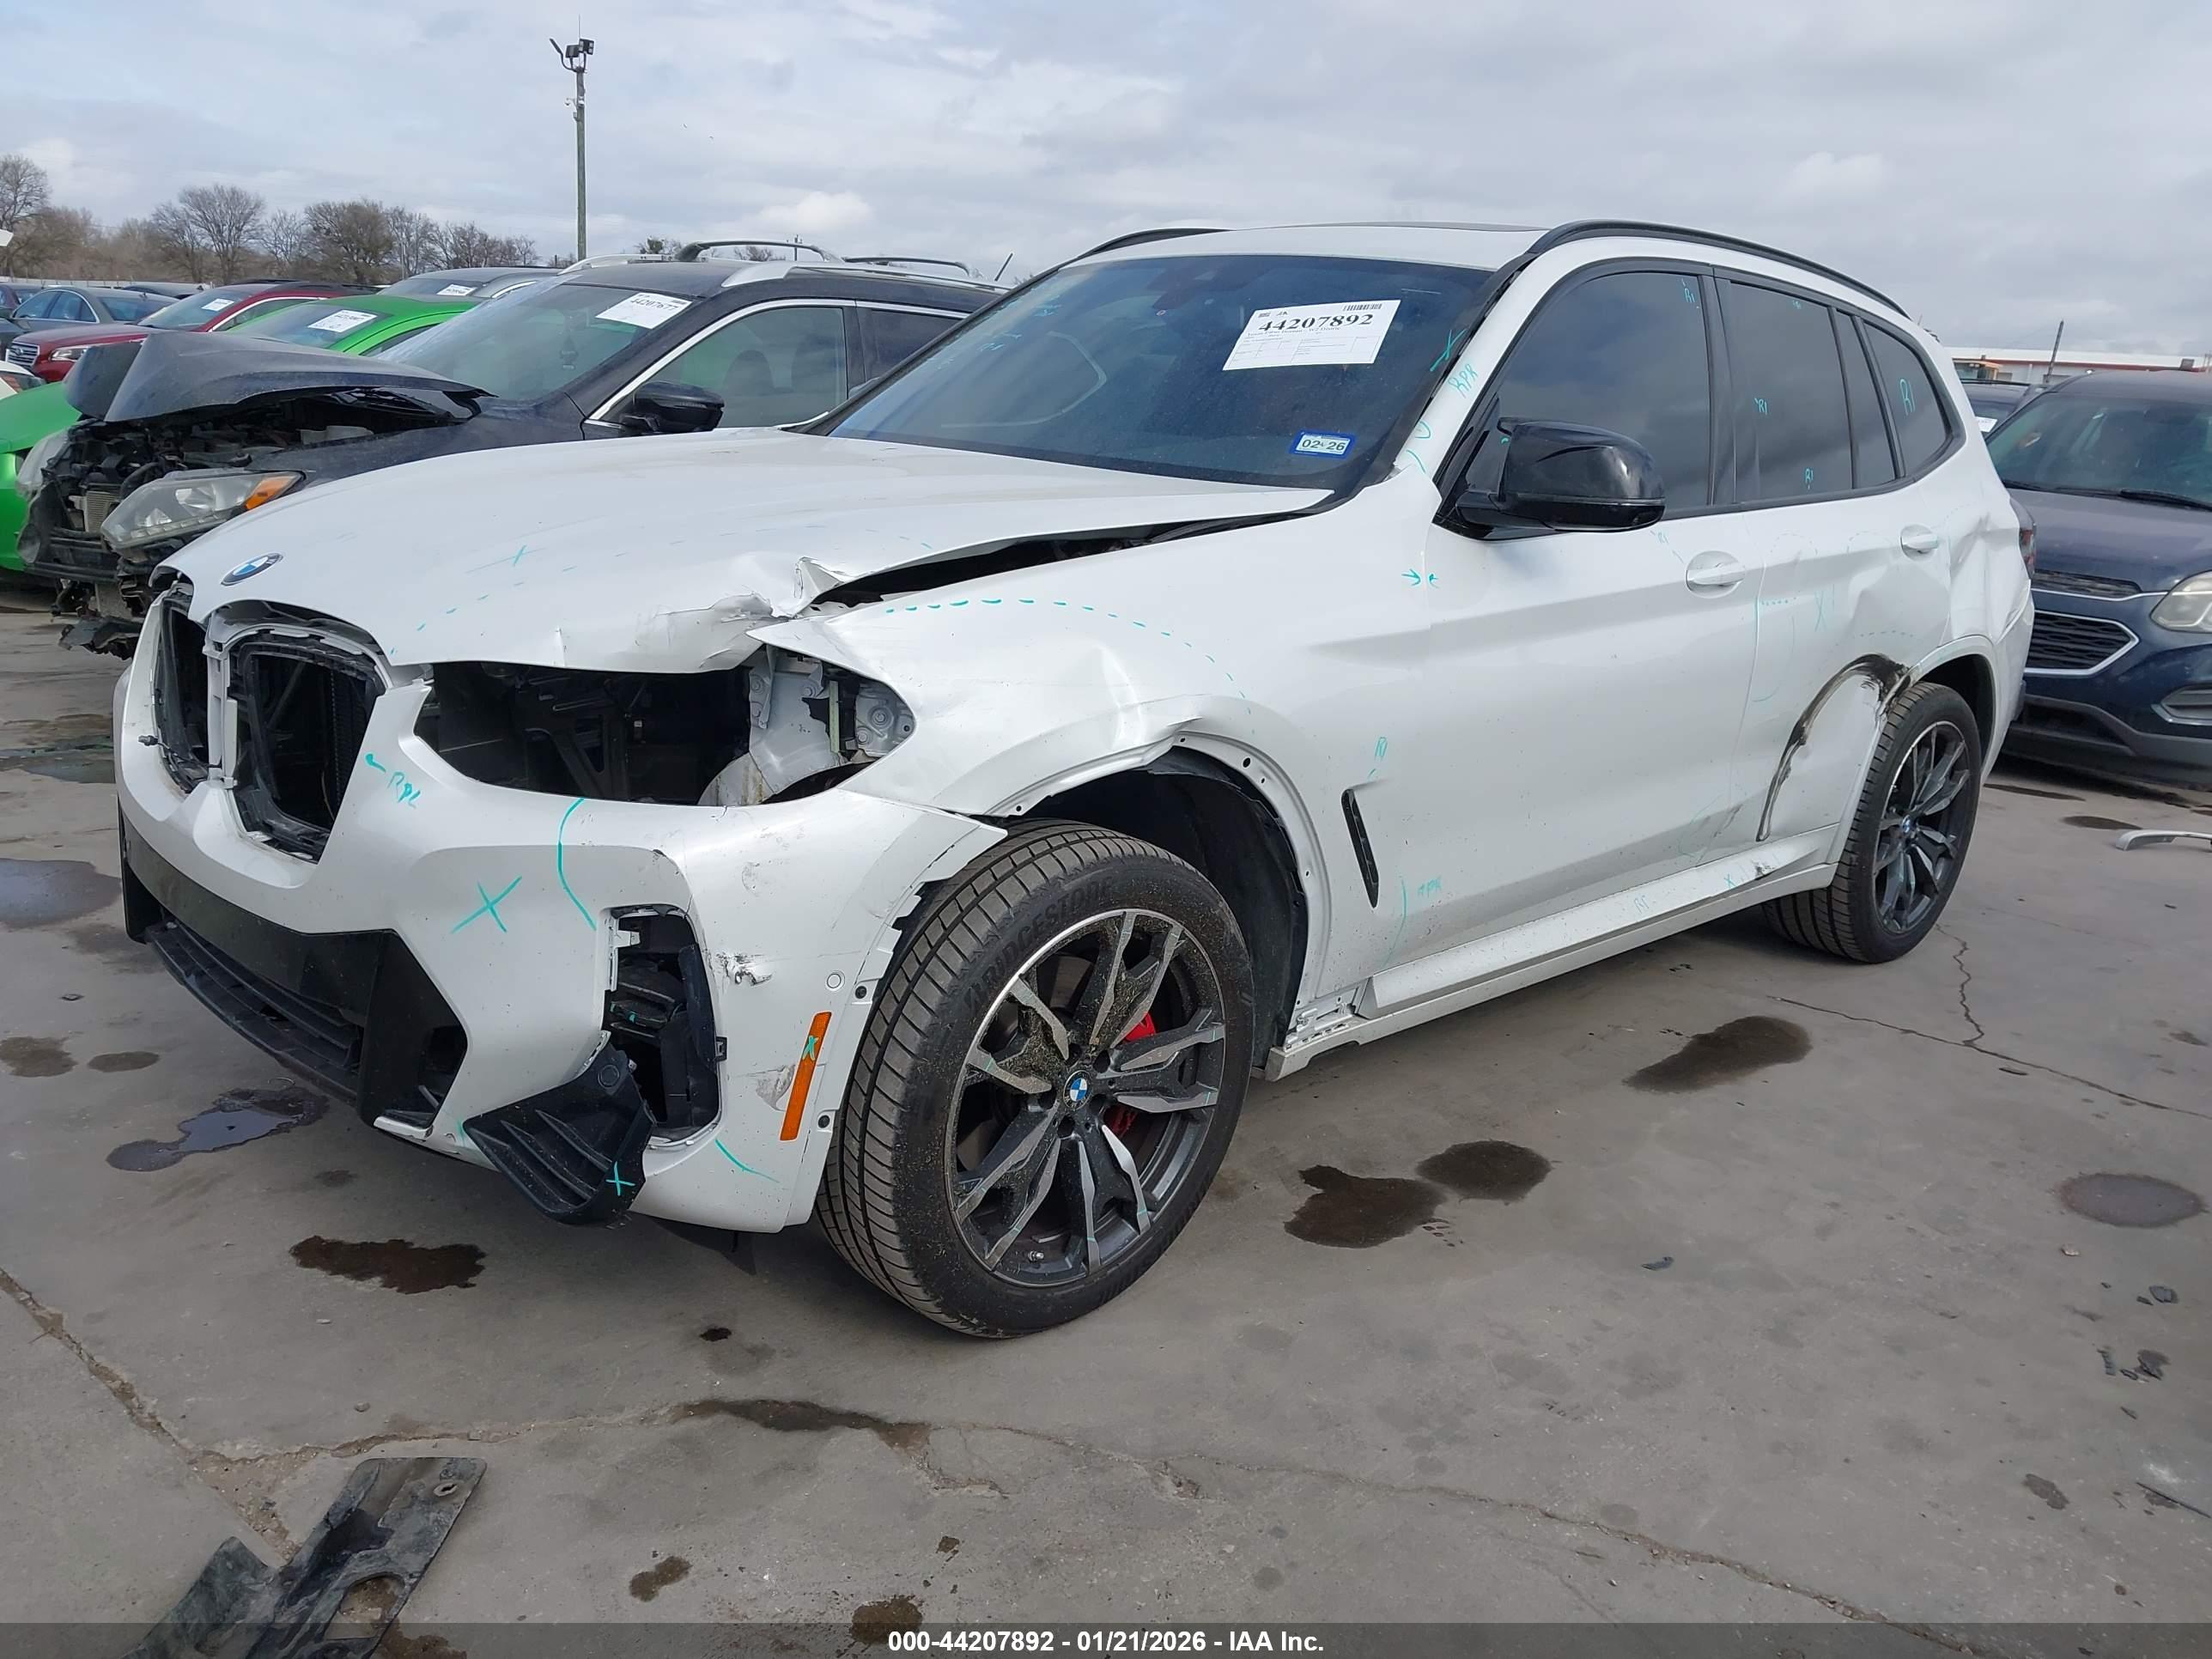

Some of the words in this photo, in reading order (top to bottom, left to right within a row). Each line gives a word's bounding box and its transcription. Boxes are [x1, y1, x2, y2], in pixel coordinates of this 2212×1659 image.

[1258, 313, 1374, 332] 44207892
[1302, 439, 1321, 449] 02
[1326, 441, 1346, 451] 26
